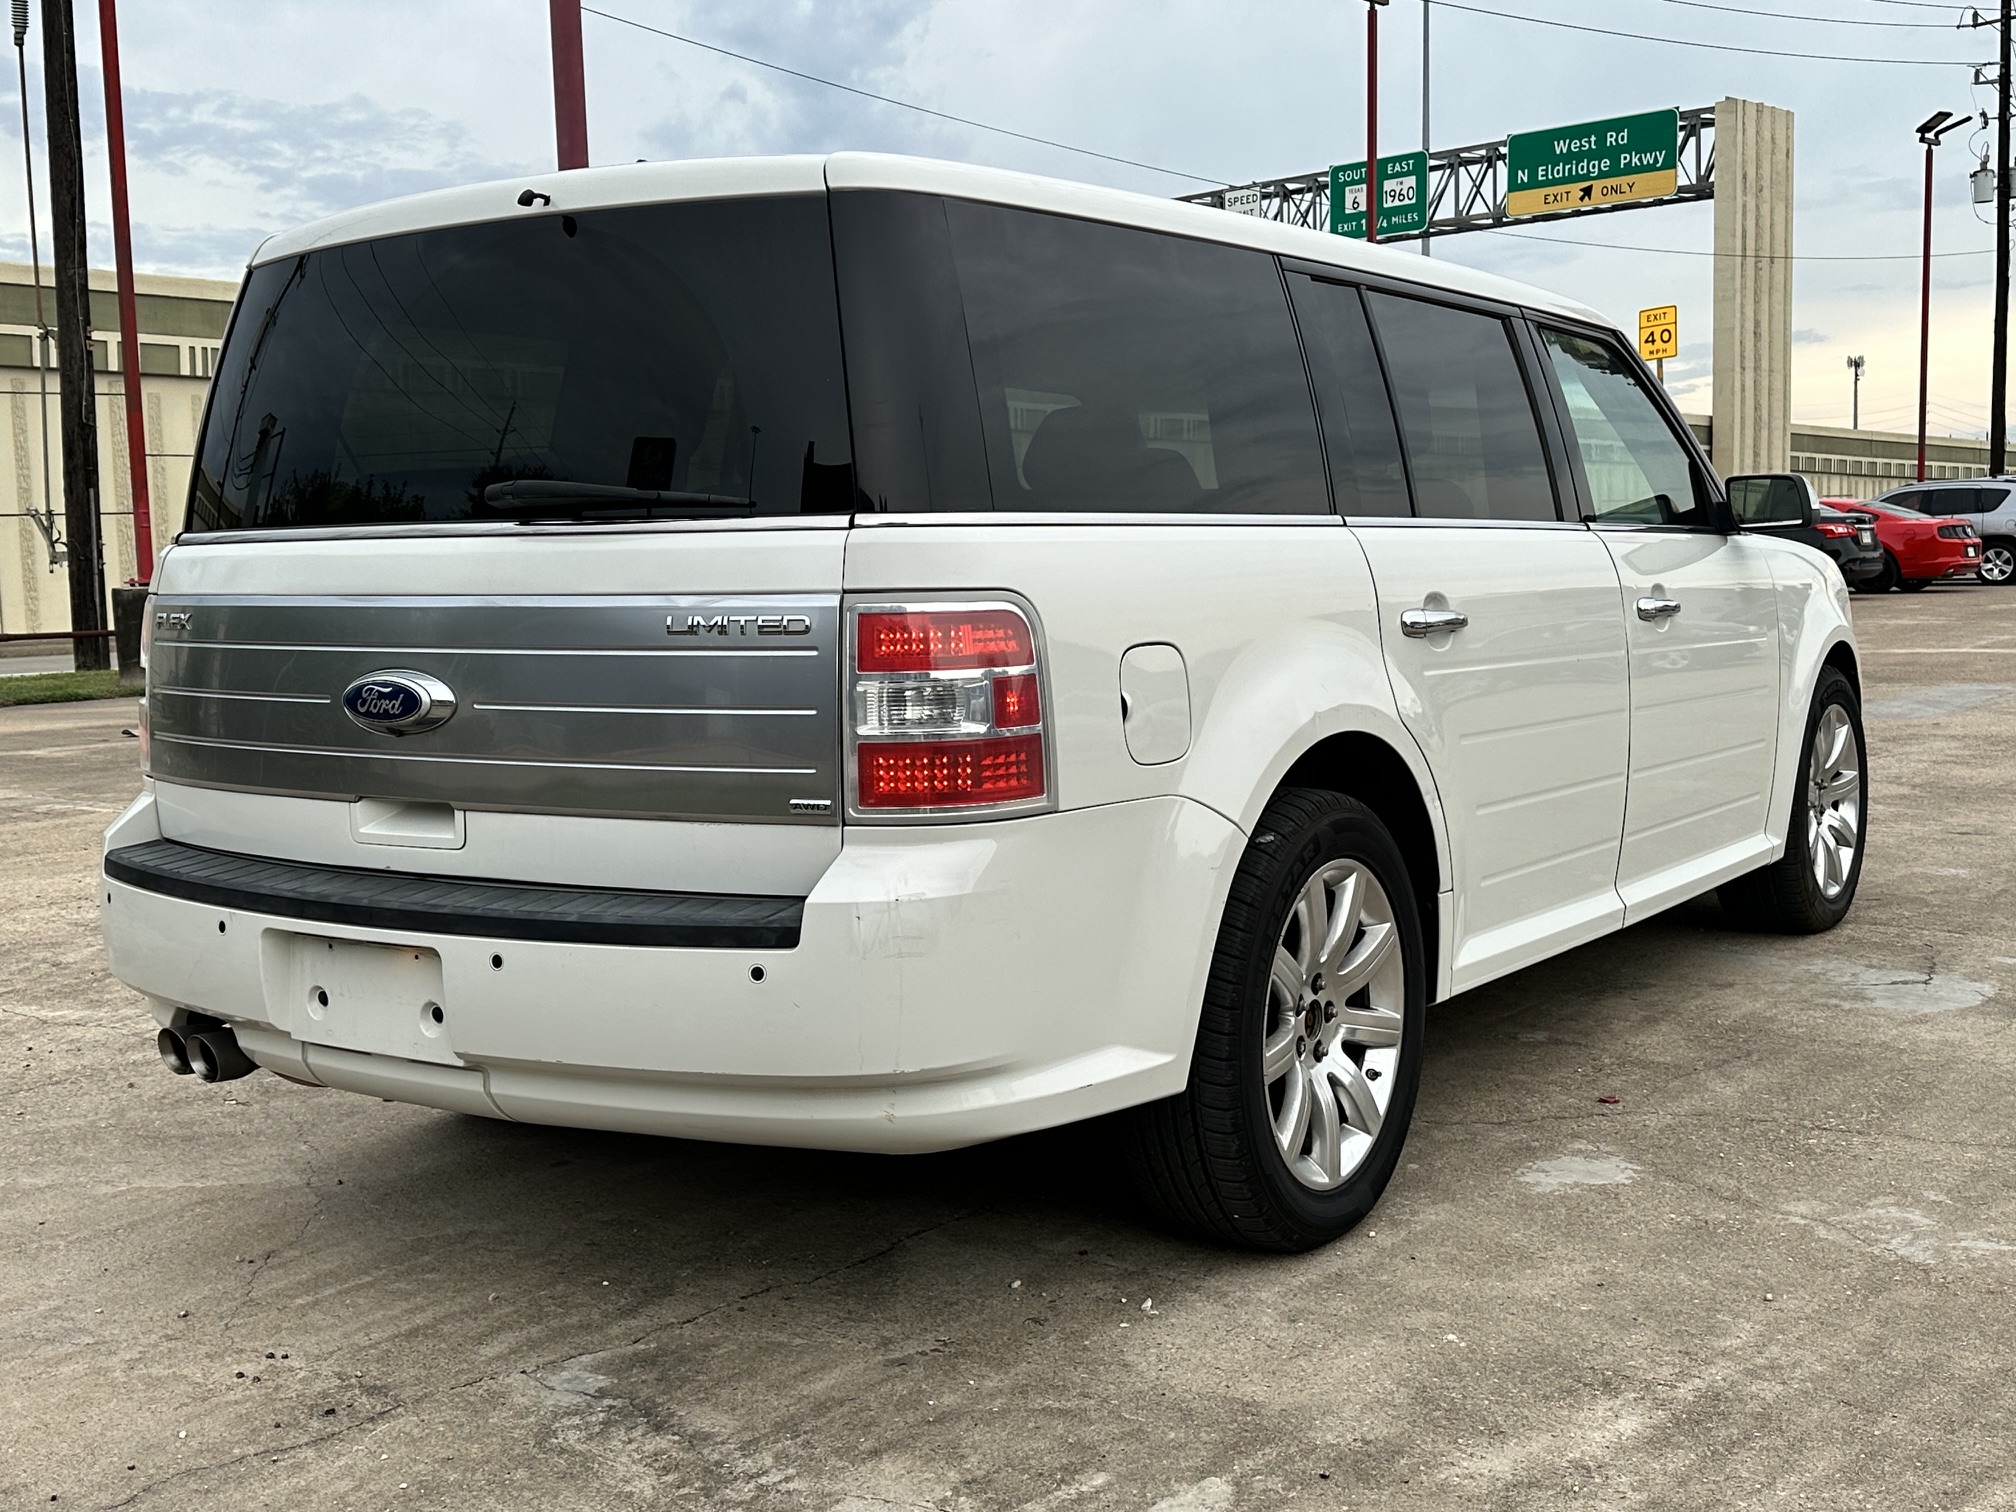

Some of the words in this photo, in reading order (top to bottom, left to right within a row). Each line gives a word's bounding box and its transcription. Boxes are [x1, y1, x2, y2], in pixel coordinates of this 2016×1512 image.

[1553, 134, 1597, 154] West
[1606, 128, 1628, 147] Rd
[1338, 168, 1367, 182] SOUT
[1387, 160, 1414, 174] EAST
[1517, 168, 1528, 184] N
[1537, 158, 1610, 181] Eldridge
[1620, 150, 1666, 169] Pkwy
[1348, 186, 1364, 195] TEXAS
[1384, 186, 1415, 205] 1960
[1543, 190, 1571, 205] EXIT
[1600, 182, 1636, 197] ONLY
[1227, 193, 1259, 207] SPEED
[1352, 195, 1360, 210] 6
[1337, 222, 1357, 232] EXIT
[1391, 212, 1419, 225] MILES
[1646, 312, 1667, 323] EXIT
[1644, 328, 1672, 346] 40
[1649, 347, 1667, 356] MPH
[666, 615, 812, 636] LIMITED
[357, 685, 404, 714] Ford
